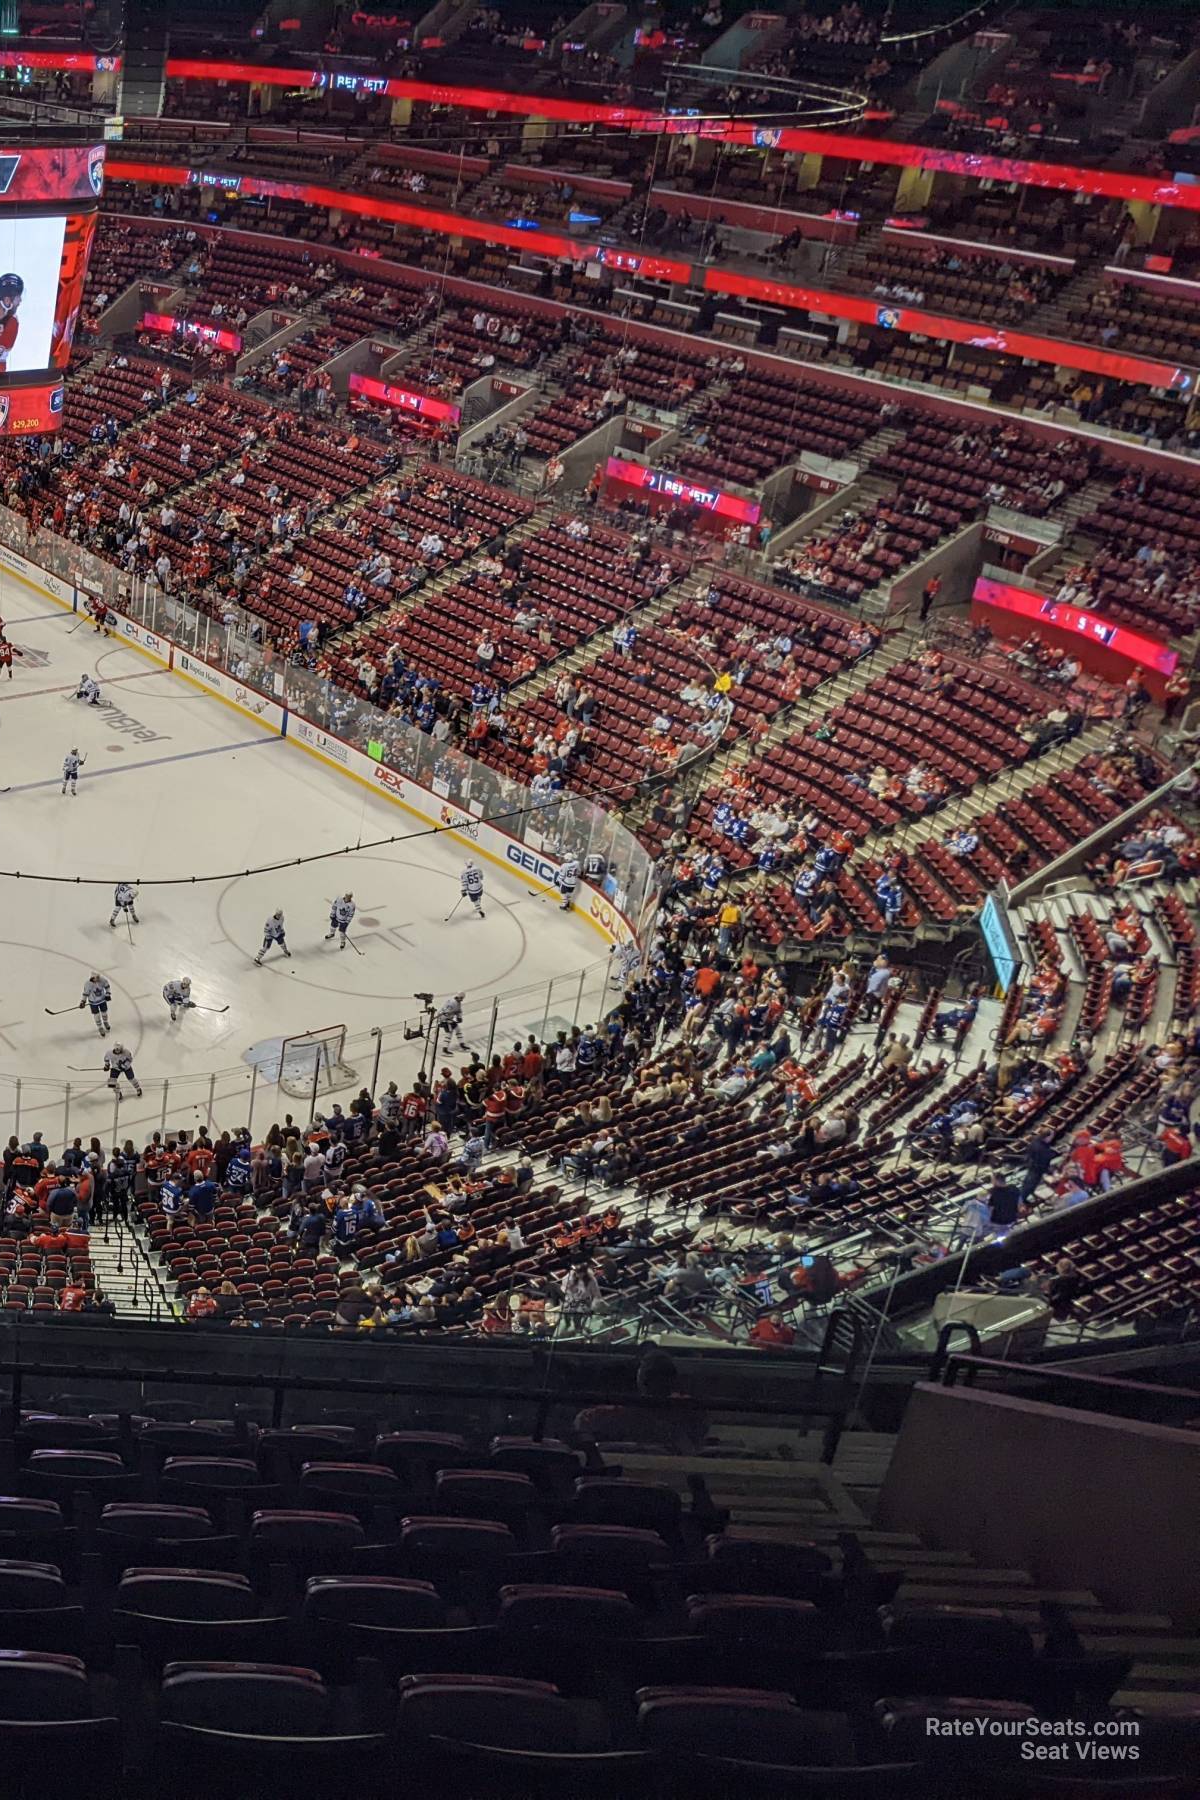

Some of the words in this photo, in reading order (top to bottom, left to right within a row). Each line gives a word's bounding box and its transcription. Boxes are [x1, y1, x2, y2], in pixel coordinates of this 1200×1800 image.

[12, 419, 39, 429] $29,200
[206, 673, 221, 687] Health
[375, 767, 404, 790] DEX
[588, 862, 598, 872] 17
[467, 873, 479, 885] 65
[591, 895, 628, 945] SOLIS
[404, 1103, 417, 1117] 16
[230, 1169, 244, 1184] 34
[345, 1219, 356, 1235] 16
